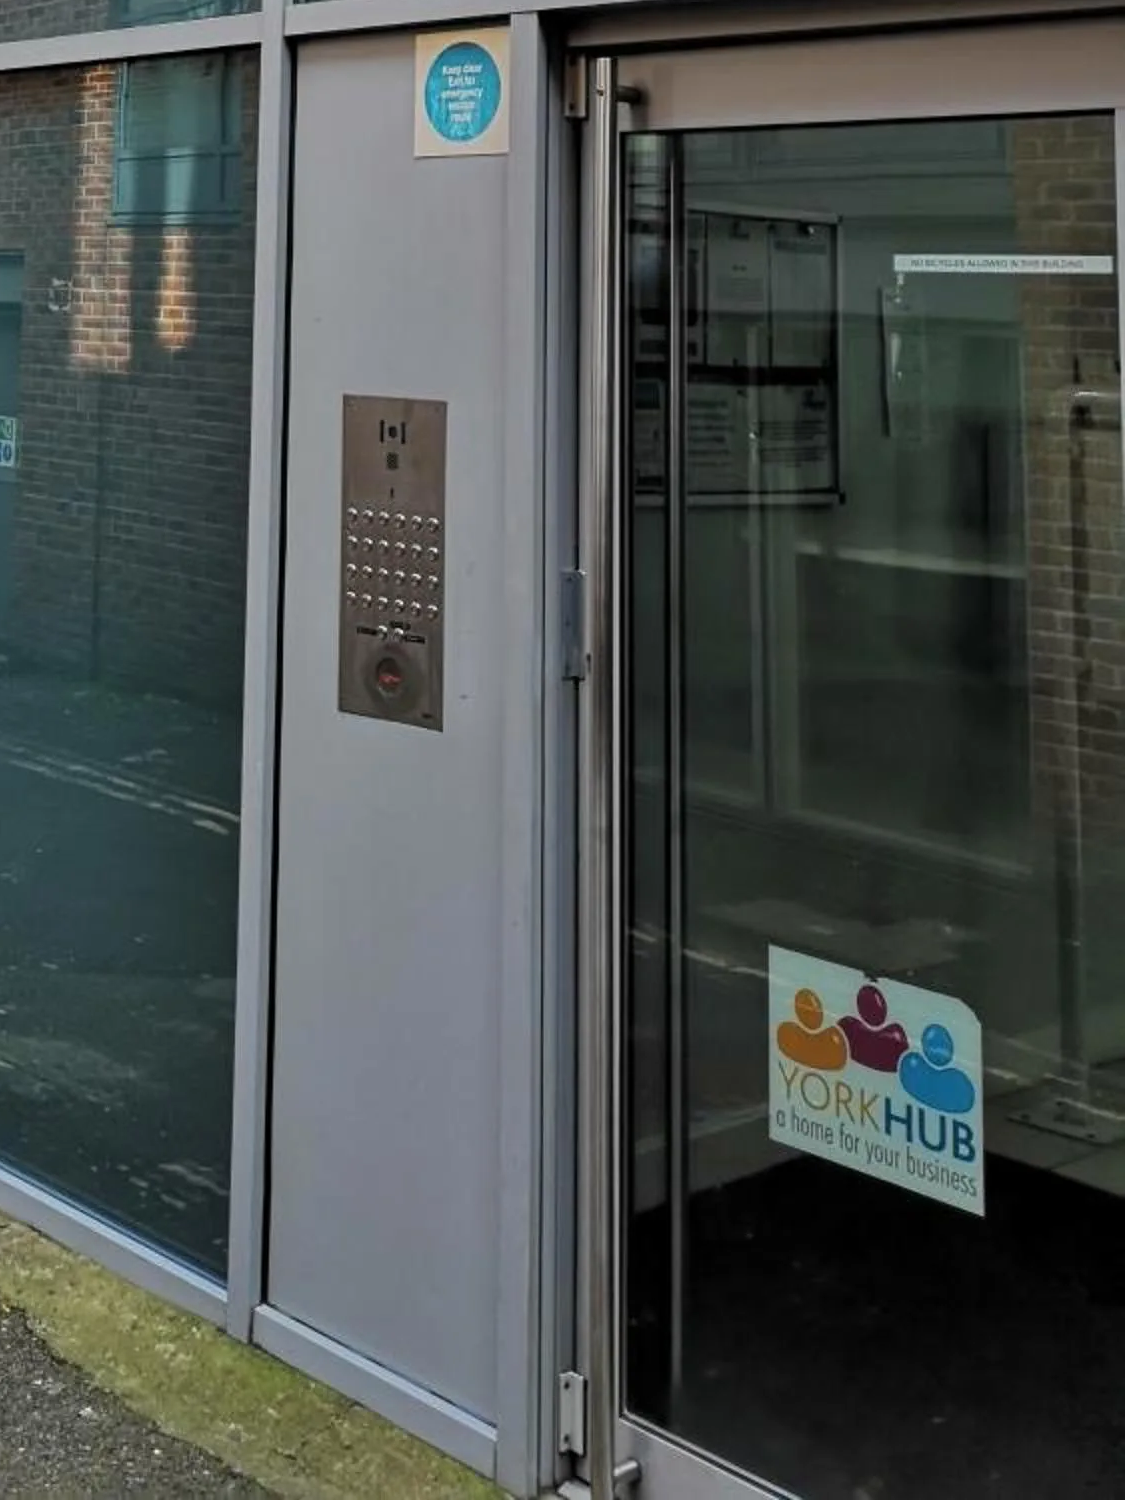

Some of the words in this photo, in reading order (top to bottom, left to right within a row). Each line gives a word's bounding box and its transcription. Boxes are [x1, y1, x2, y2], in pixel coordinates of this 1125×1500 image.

[967, 259, 1008, 269] ALLOWED
[1042, 260, 1084, 269] BUILDING
[776, 1109, 786, 1127] a
[791, 1105, 833, 1144] home
[839, 1122, 859, 1153] for
[865, 1140, 900, 1168] your
[906, 1146, 977, 1197] business
